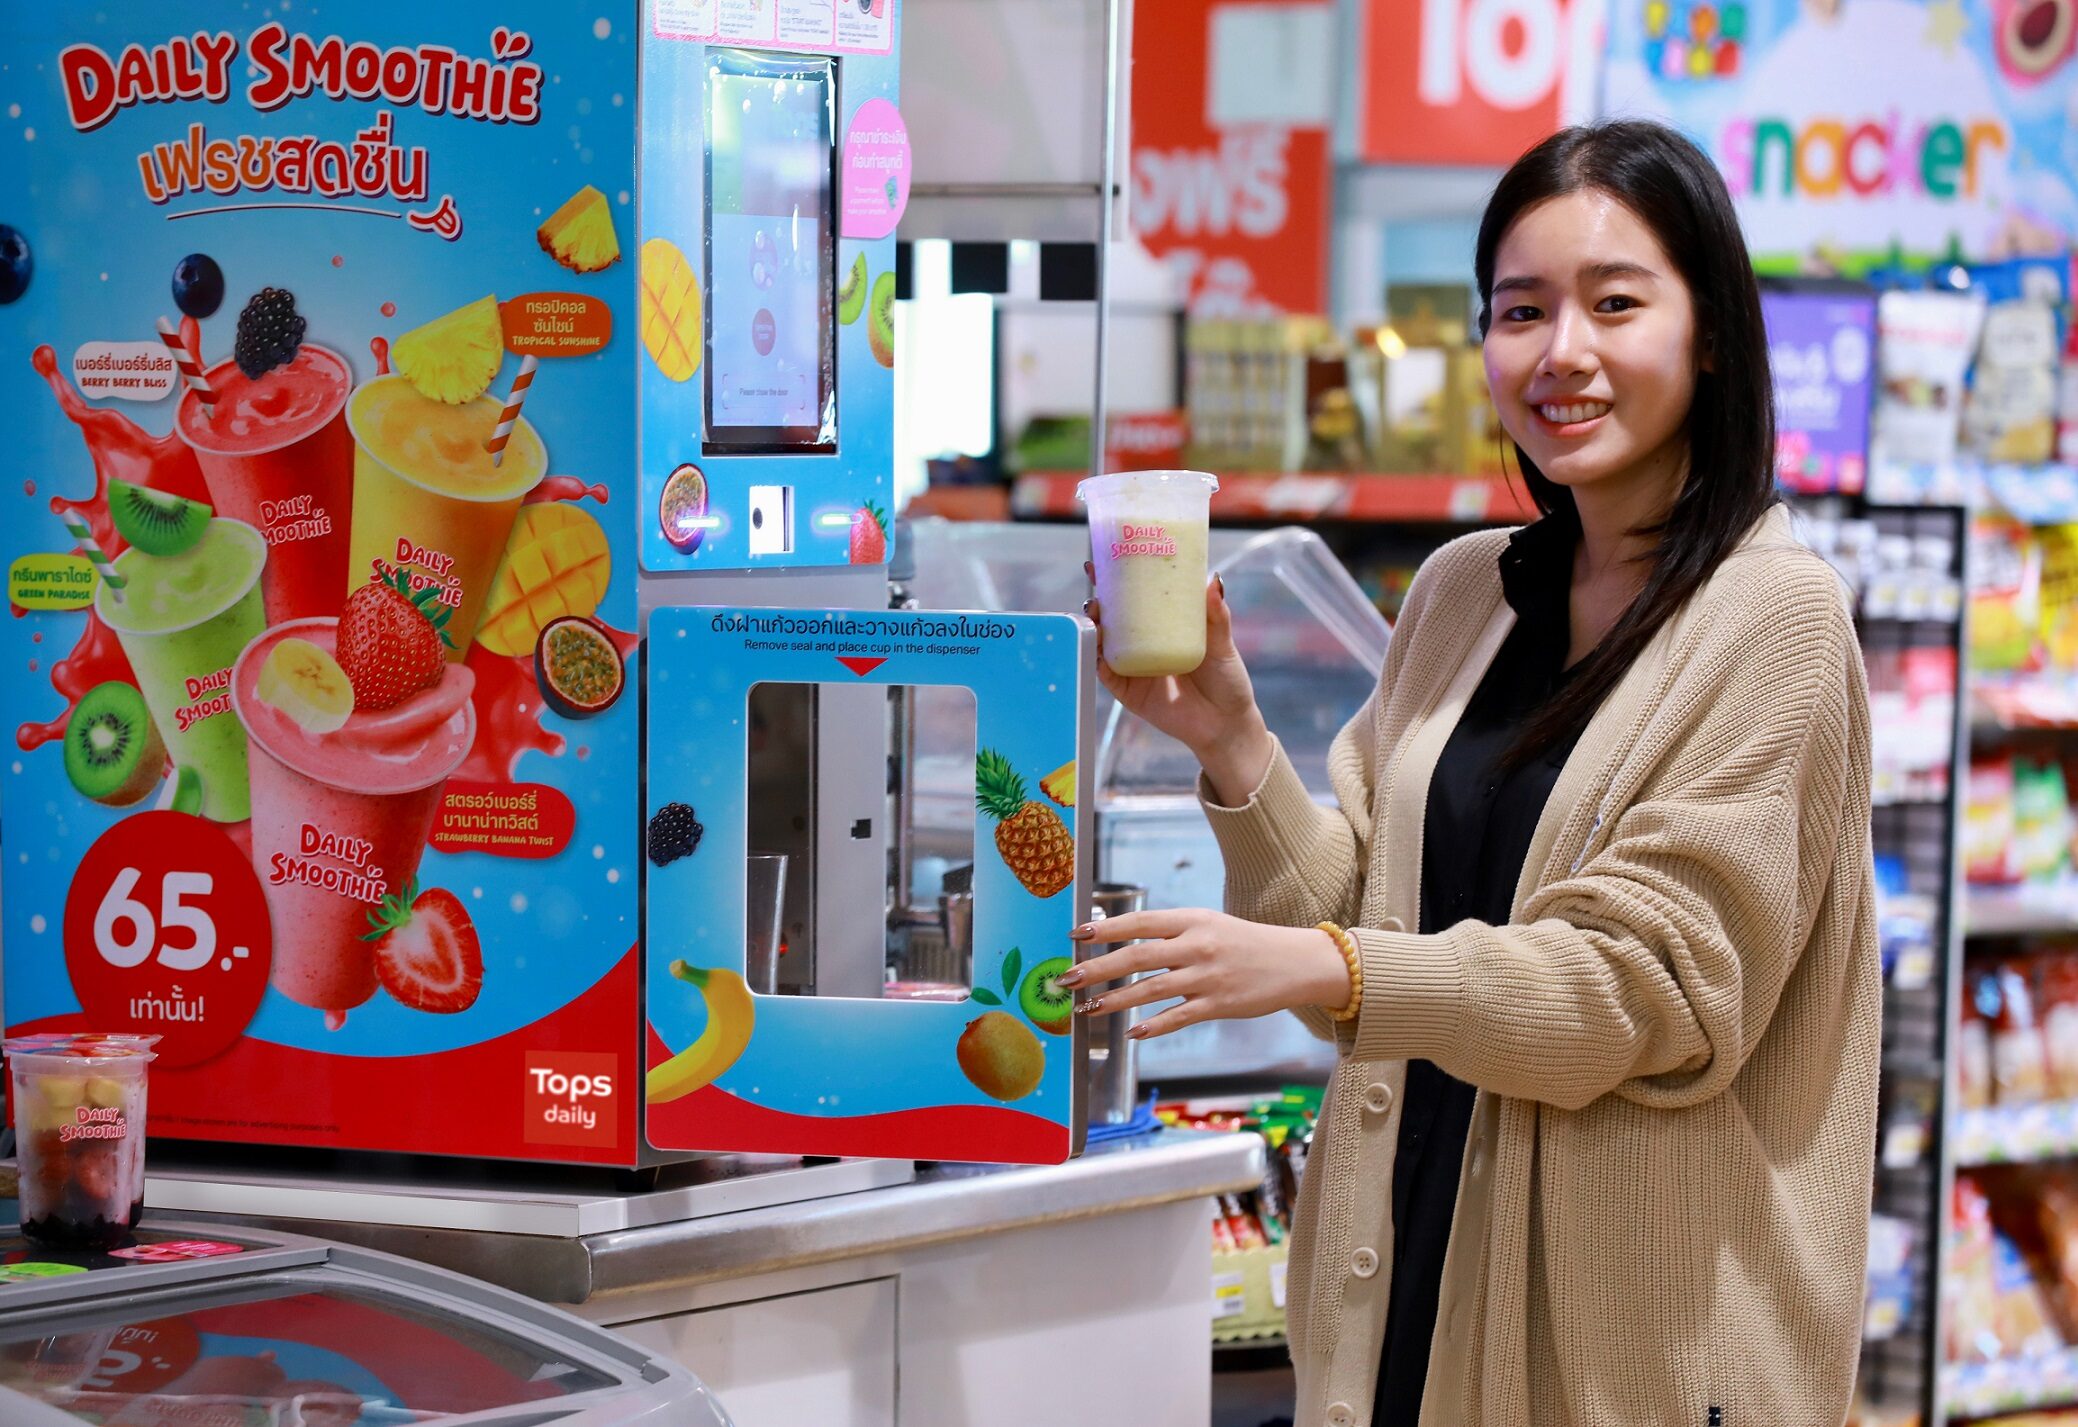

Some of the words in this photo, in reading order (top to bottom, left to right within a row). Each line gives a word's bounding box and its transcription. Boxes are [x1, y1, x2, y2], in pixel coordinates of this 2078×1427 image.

[59, 32, 238, 131] DAILY
[247, 22, 541, 124] SMOOTHIE
[138, 112, 429, 205] เฟรชสดชื่น
[526, 299, 587, 314] ทรอปิคอล
[533, 315, 575, 333] ซันไชน์
[512, 335, 557, 346] TROPICAL
[558, 336, 600, 346] SUNSHINE
[75, 352, 173, 371] เบอร์รี่เบอร์รี่บลิส
[81, 377, 110, 388] BERRY
[112, 377, 141, 388] BERRY
[143, 378, 167, 388] BLISS
[259, 494, 313, 528] DAILY
[260, 515, 332, 547] MOOTHIE
[1121, 523, 1167, 542] DAILY
[395, 535, 454, 577] DAILY
[1110, 538, 1177, 561] SMOOTHIE
[13, 566, 92, 584] กรีนพาราไดซ์
[17, 588, 46, 599] GREEN
[47, 589, 91, 600] PARADISE
[711, 613, 1016, 639] ดึงฝาแก้วออกและวางแก้วลงในช่อง
[744, 639, 788, 651] Remove
[790, 640, 813, 651] seal
[814, 641, 836, 652] and
[837, 641, 868, 655] place
[870, 643, 892, 655] cup
[893, 642, 904, 653] in
[905, 643, 924, 654] the
[925, 643, 981, 657] dispenser
[184, 667, 234, 702] DAILY
[173, 692, 232, 733] SMOOT
[445, 790, 537, 811] สตรอว์เบอร์รี่
[443, 811, 539, 831] บานาน่าทวิสต์
[300, 822, 373, 868] DAILY
[434, 832, 490, 844] STRAWBERRY
[491, 834, 527, 845] BANANA
[528, 835, 555, 846] TWIST
[269, 851, 388, 905] SMOOTHIE
[93, 866, 250, 972] 65.-
[130, 984, 205, 1022] เท่านั้น!
[529, 1067, 613, 1104] Tops
[75, 1106, 119, 1125] DAILY
[543, 1103, 597, 1130] daily
[59, 1118, 127, 1142] SMOOTHIE
